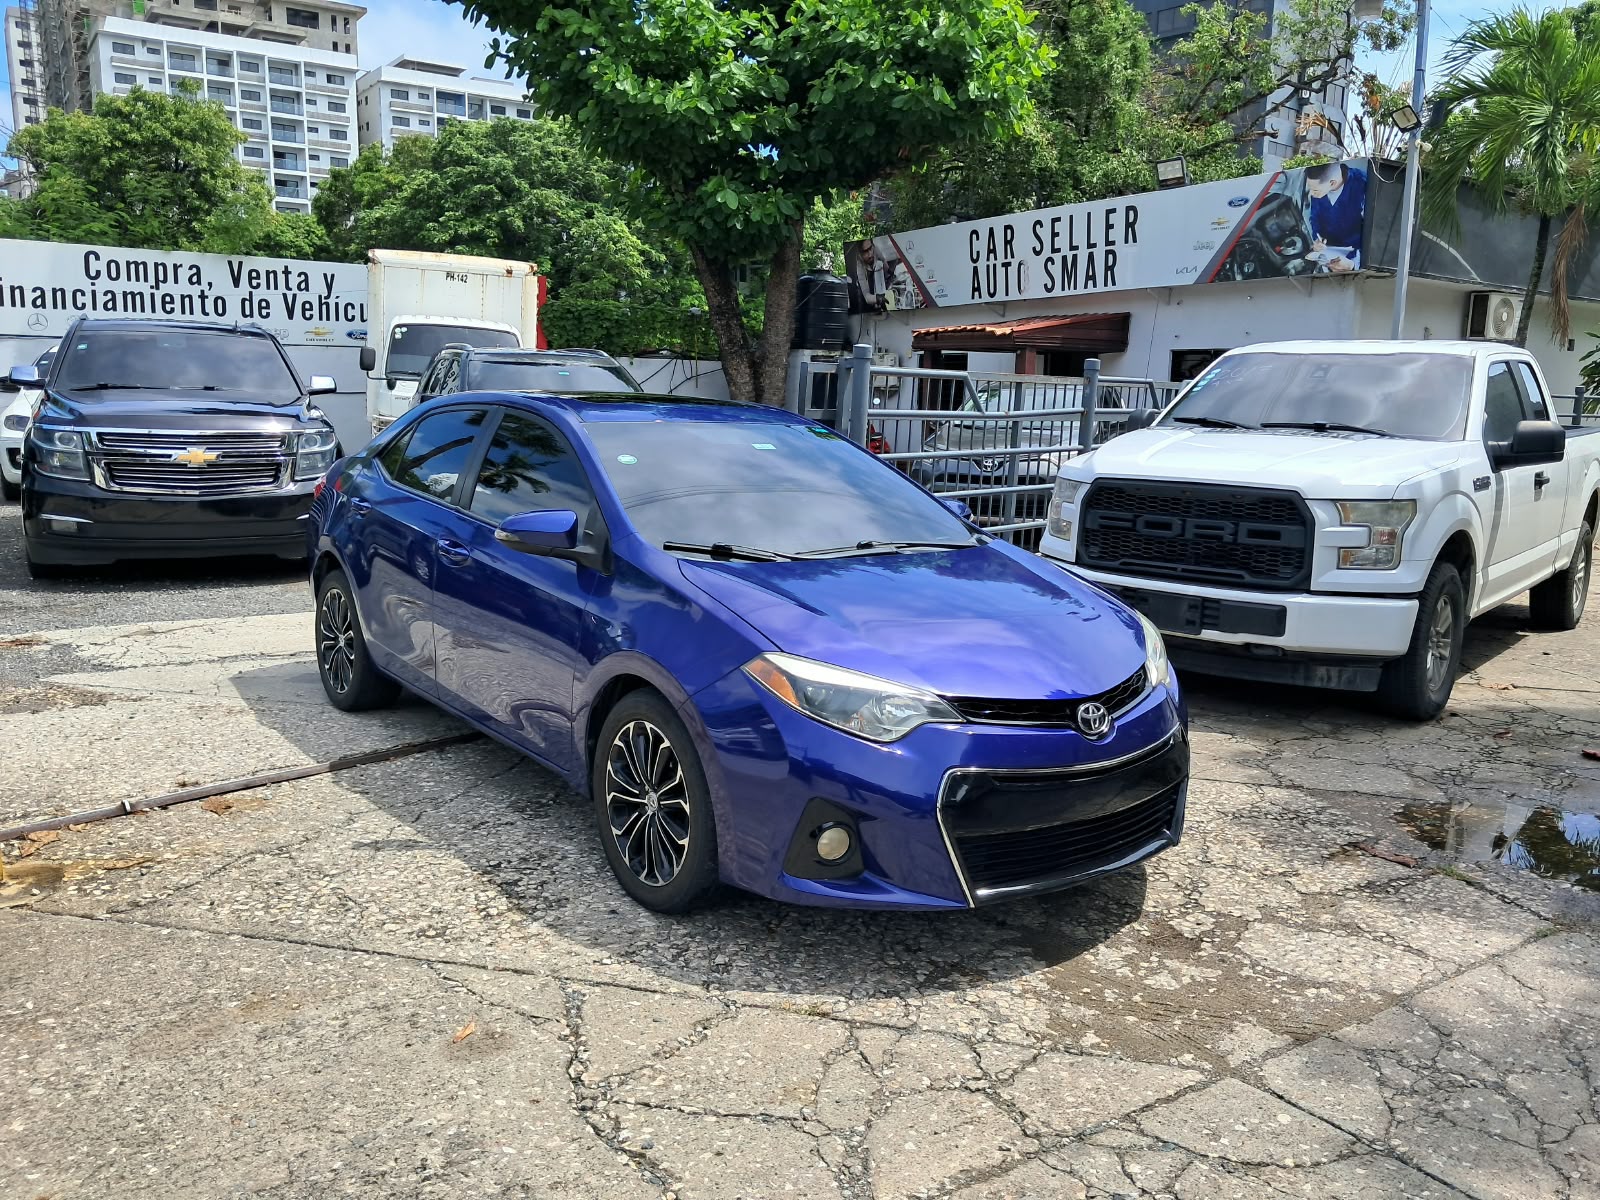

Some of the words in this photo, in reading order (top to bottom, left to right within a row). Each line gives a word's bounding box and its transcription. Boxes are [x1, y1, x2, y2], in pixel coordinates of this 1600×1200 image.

[969, 224, 1015, 264] CAR
[1032, 205, 1138, 256] SELLER
[84, 250, 213, 291] Compra,
[227, 260, 309, 292] Venta
[323, 273, 335, 299] y
[445, 272, 468, 284] PH-142
[971, 260, 1028, 300] AUTO
[1043, 249, 1118, 293] SMAR
[241, 291, 271, 319] de
[1089, 510, 1304, 548] FORD
